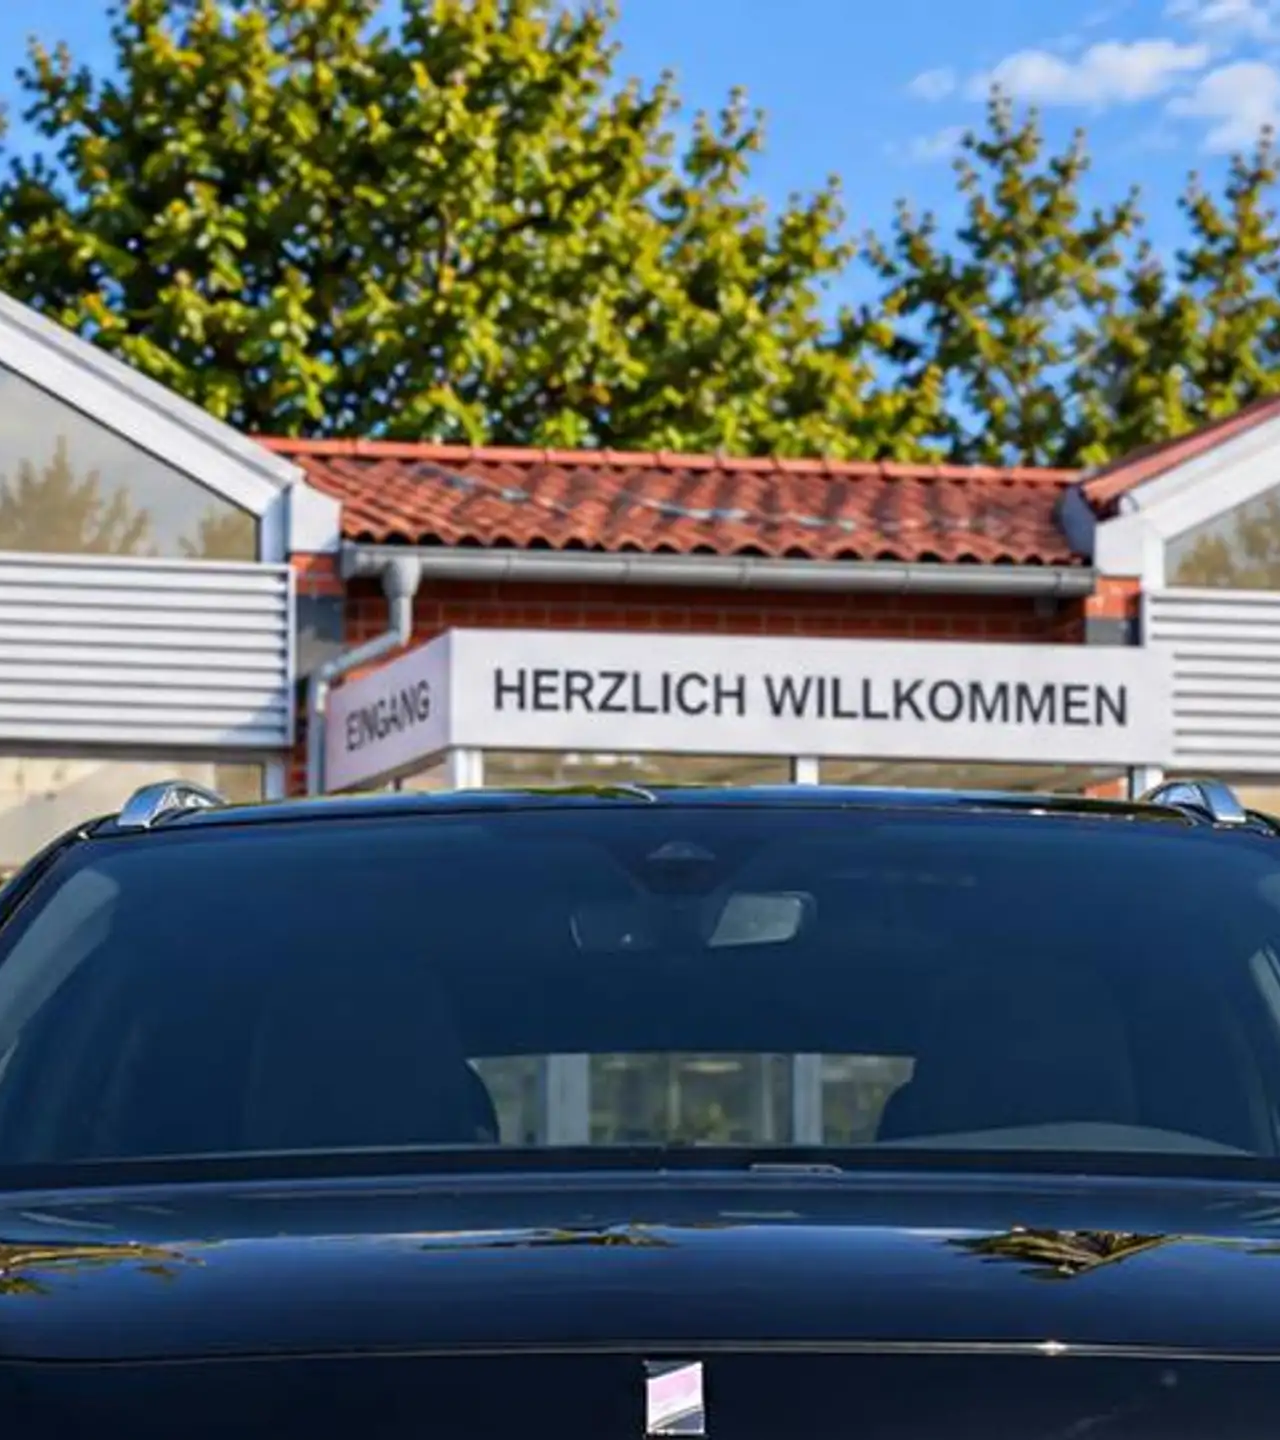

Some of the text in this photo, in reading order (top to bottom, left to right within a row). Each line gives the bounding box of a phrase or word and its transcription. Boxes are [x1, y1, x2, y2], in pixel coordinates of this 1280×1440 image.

[345, 679, 432, 753] EINGANG
[493, 667, 1129, 728] HERZLICH WILLKOMMEN
